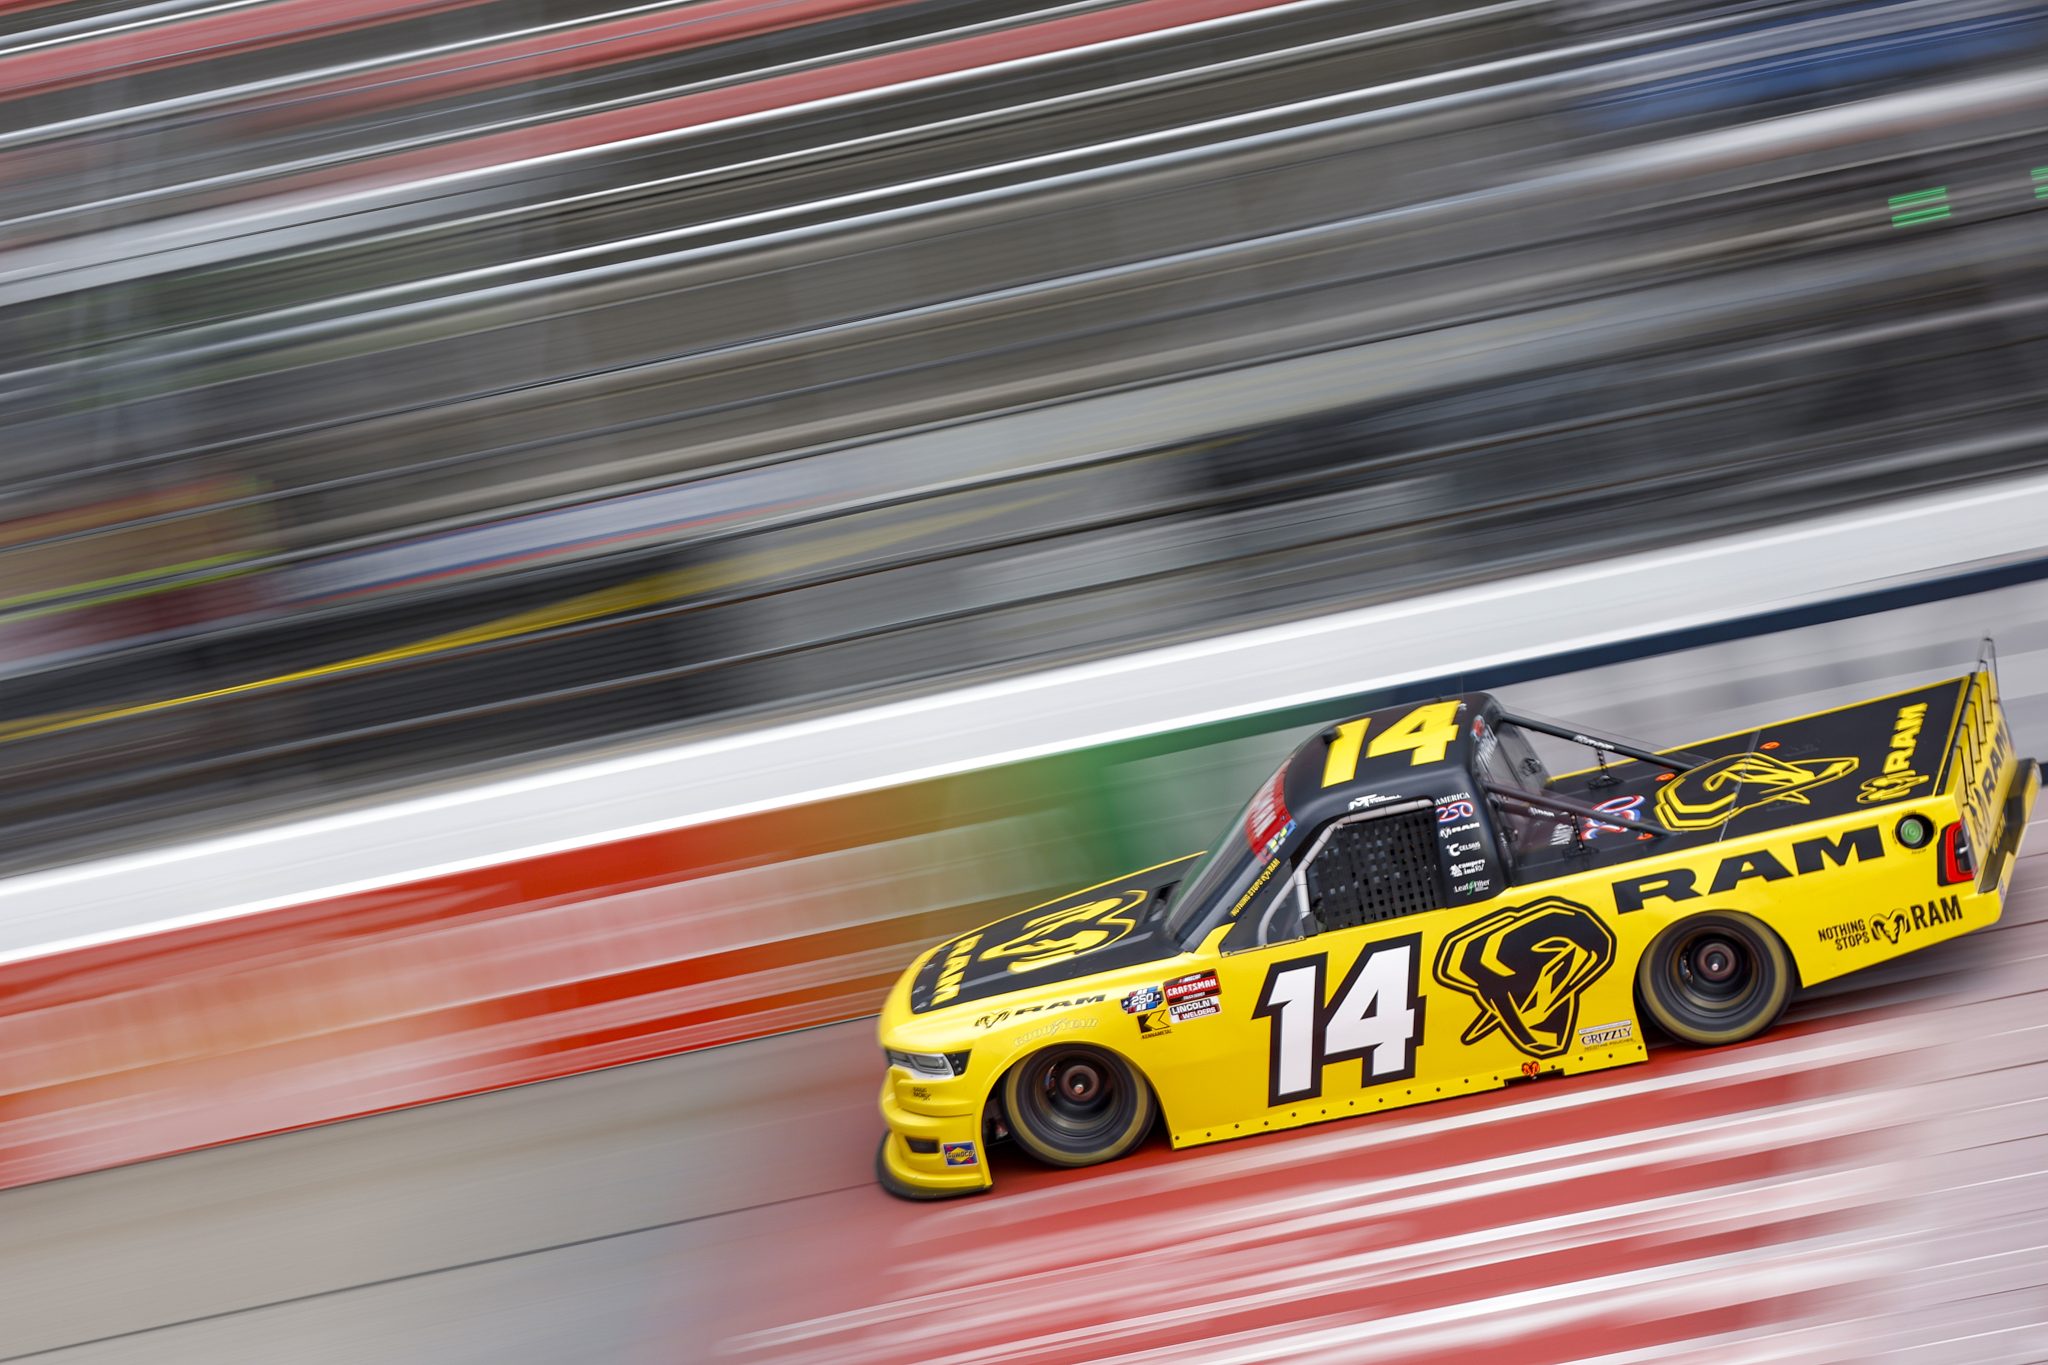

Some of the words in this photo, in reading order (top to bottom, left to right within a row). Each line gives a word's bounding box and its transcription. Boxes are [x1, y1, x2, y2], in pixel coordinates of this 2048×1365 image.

[1321, 699, 1462, 789] 14
[1882, 702, 1928, 774] RAM
[1435, 791, 1471, 806] AMERICA
[1435, 801, 1474, 822] 250
[1612, 825, 1885, 915] RAM
[1910, 894, 1964, 931] RAM
[1818, 918, 1867, 943] NOTHING
[1834, 931, 1871, 951] STOPS
[930, 933, 984, 1007] RAM
[1165, 978, 1217, 997] CRAFTSMAN
[1015, 994, 1106, 1016] RAM
[1131, 992, 1154, 1006] 250
[1171, 999, 1211, 1015] LINCOLN
[1181, 1006, 1217, 1020] WELDERS
[1260, 938, 1420, 1100] 14
[1013, 1016, 1100, 1048] GOODYEAR
[1141, 1028, 1173, 1040] KENNAMETAL
[1580, 1026, 1632, 1047] GRIZZLY
